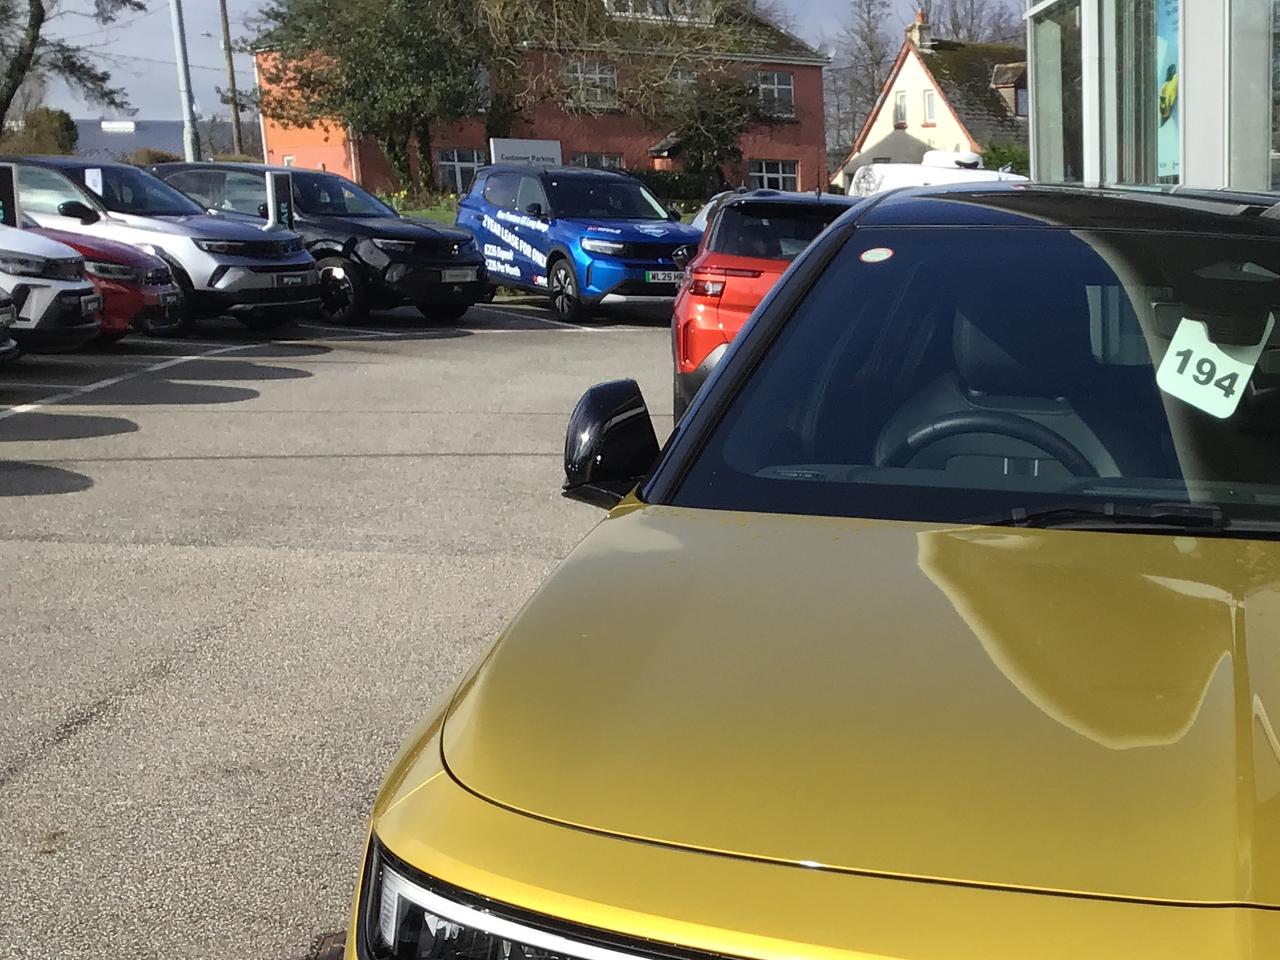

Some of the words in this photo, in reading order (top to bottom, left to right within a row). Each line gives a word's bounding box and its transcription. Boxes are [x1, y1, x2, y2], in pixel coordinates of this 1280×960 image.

[487, 216, 501, 237] YEAR
[501, 227, 519, 250] LEASE
[519, 239, 531, 258] FOR
[532, 248, 547, 268] ONLY
[497, 246, 514, 261] Deposit
[505, 263, 521, 277] Month
[673, 272, 684, 281] HR
[1175, 348, 1240, 399] 194
